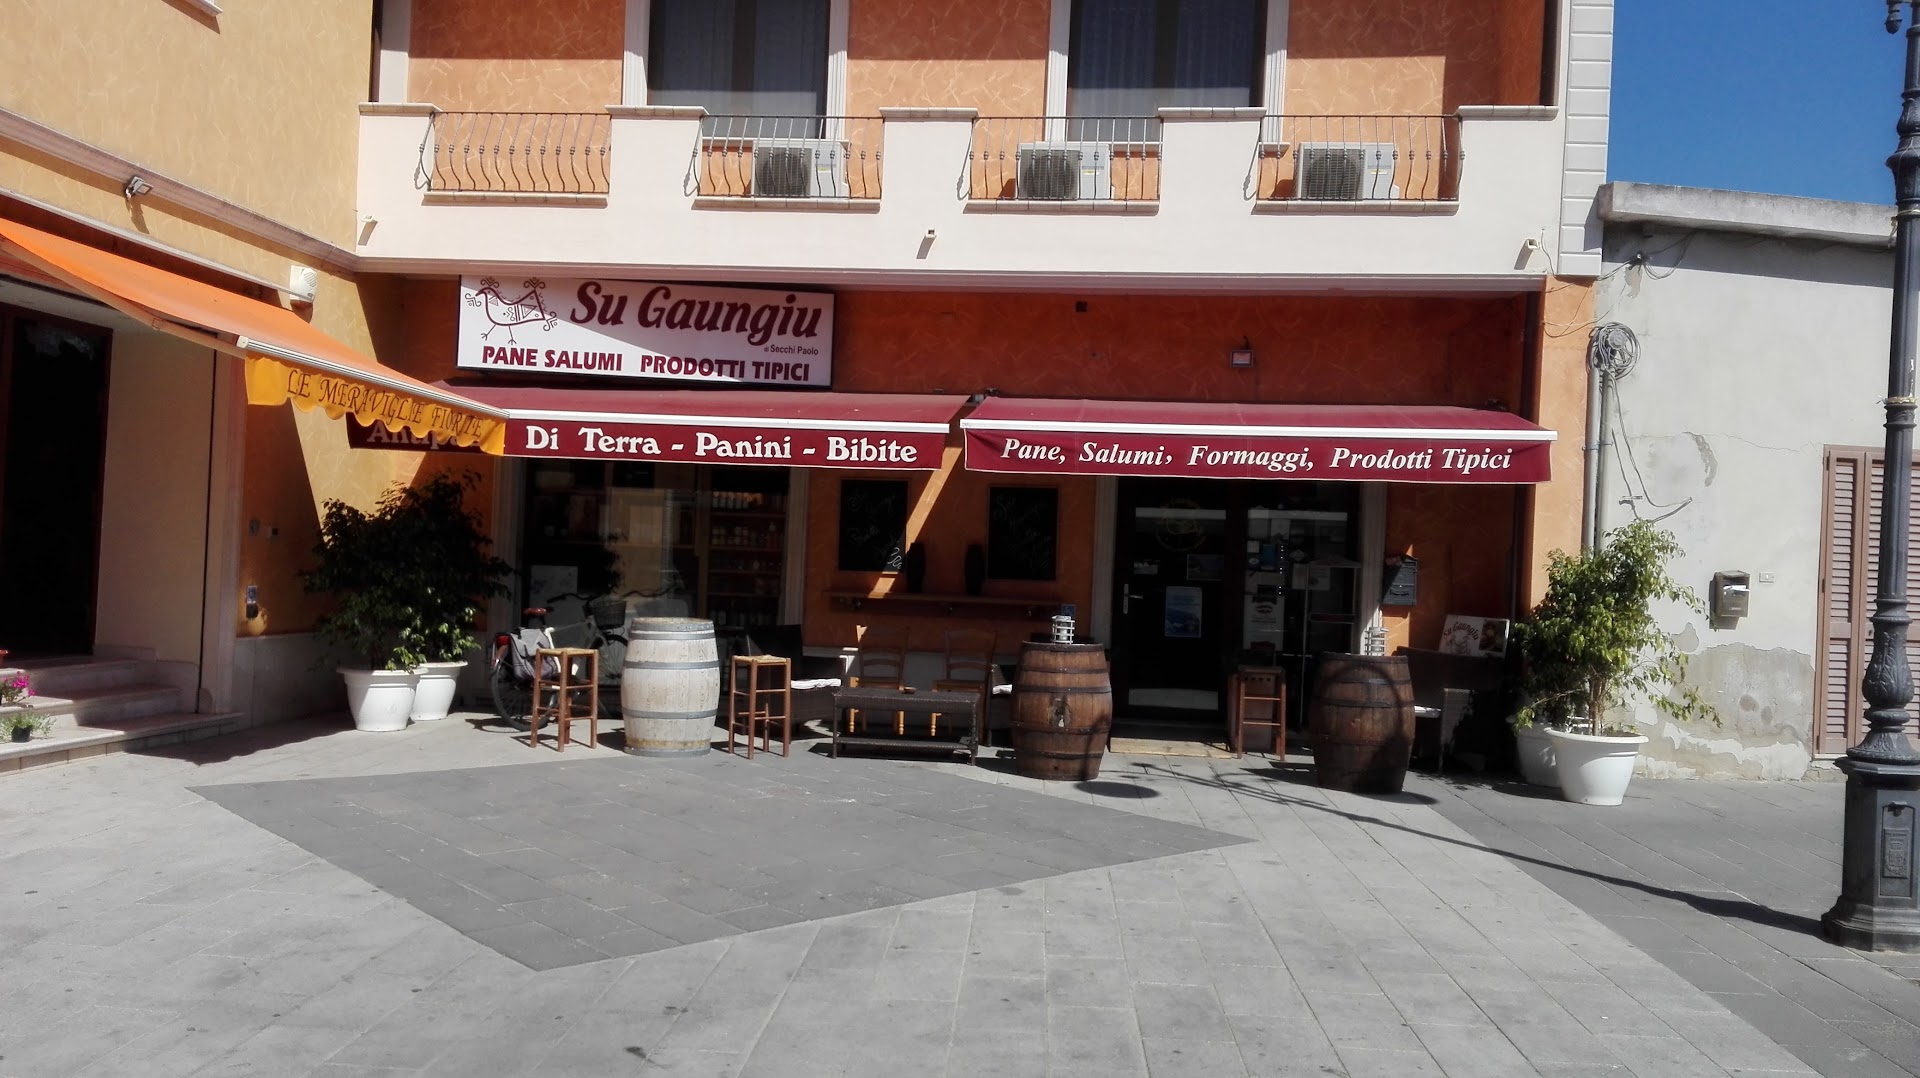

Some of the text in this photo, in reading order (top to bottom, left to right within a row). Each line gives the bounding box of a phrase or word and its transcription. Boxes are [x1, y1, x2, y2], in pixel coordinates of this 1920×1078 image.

[570, 281, 822, 346] Su Gaungiu
[482, 345, 810, 381] PANE SALUMI PRODOTTI TIPICI
[770, 344, 796, 354] Secchi
[797, 346, 819, 356] Paolo
[287, 369, 485, 438] LE MERAVIGLIE FIORITE
[526, 425, 559, 450] Di
[578, 427, 661, 454] Terra
[695, 432, 792, 458] Panini
[827, 436, 917, 462] Bibite
[1000, 438, 1513, 475] Pane, Salumi, Formaggi, Prodotti Tipici
